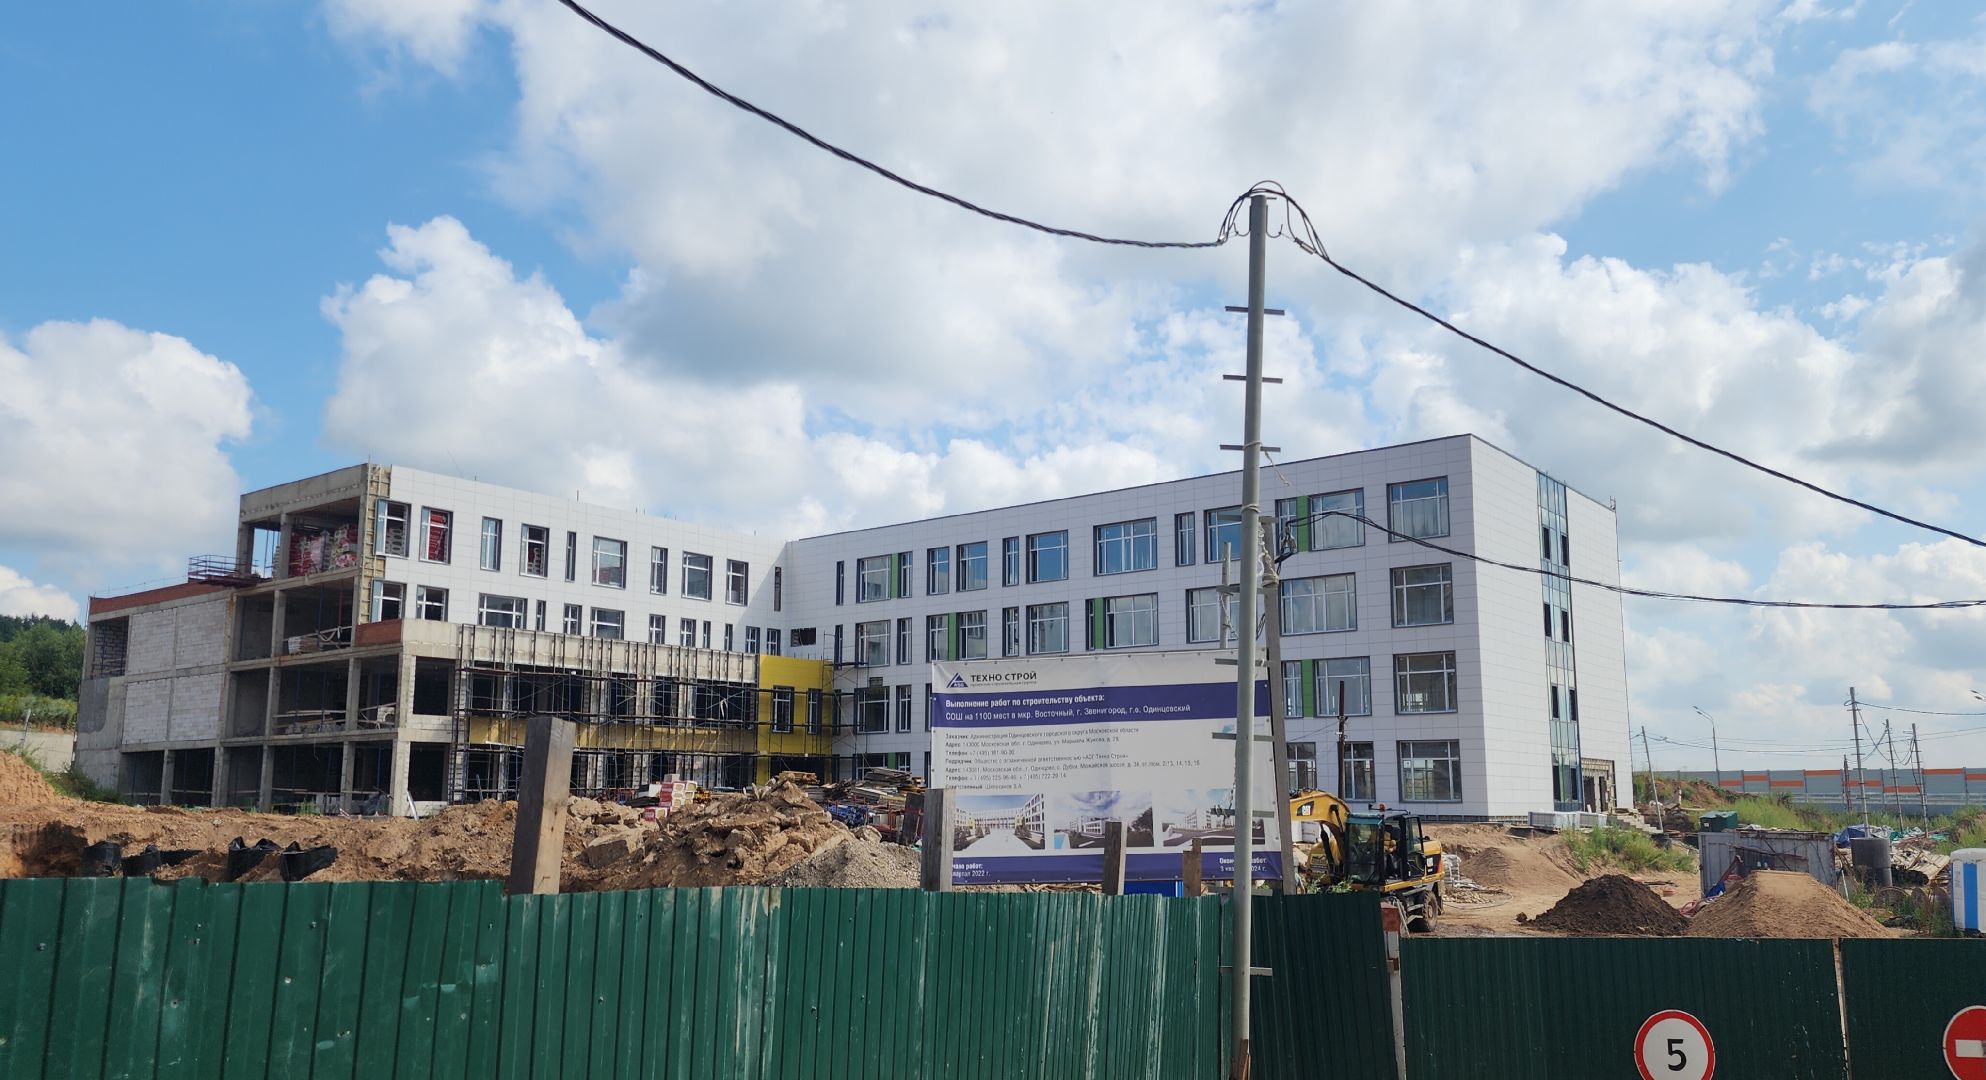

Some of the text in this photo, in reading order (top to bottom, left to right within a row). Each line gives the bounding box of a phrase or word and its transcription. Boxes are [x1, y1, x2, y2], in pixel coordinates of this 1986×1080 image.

[971, 671, 1037, 682] ТЕХНО СТРОЙ
[946, 699, 989, 708] Выполнение
[991, 699, 1010, 708] работ
[1022, 697, 1073, 707] строительству
[1074, 694, 1105, 704] объекта:
[946, 712, 963, 721] СОШ
[965, 713, 973, 721] на
[975, 712, 992, 720] 1100
[1017, 711, 1033, 721] мкр.
[1035, 708, 1074, 718] Восточный,
[1084, 706, 1128, 716] Звенигород,
[1143, 704, 1191, 714] Одинцовский
[1667, 1038, 1687, 1072] 5
